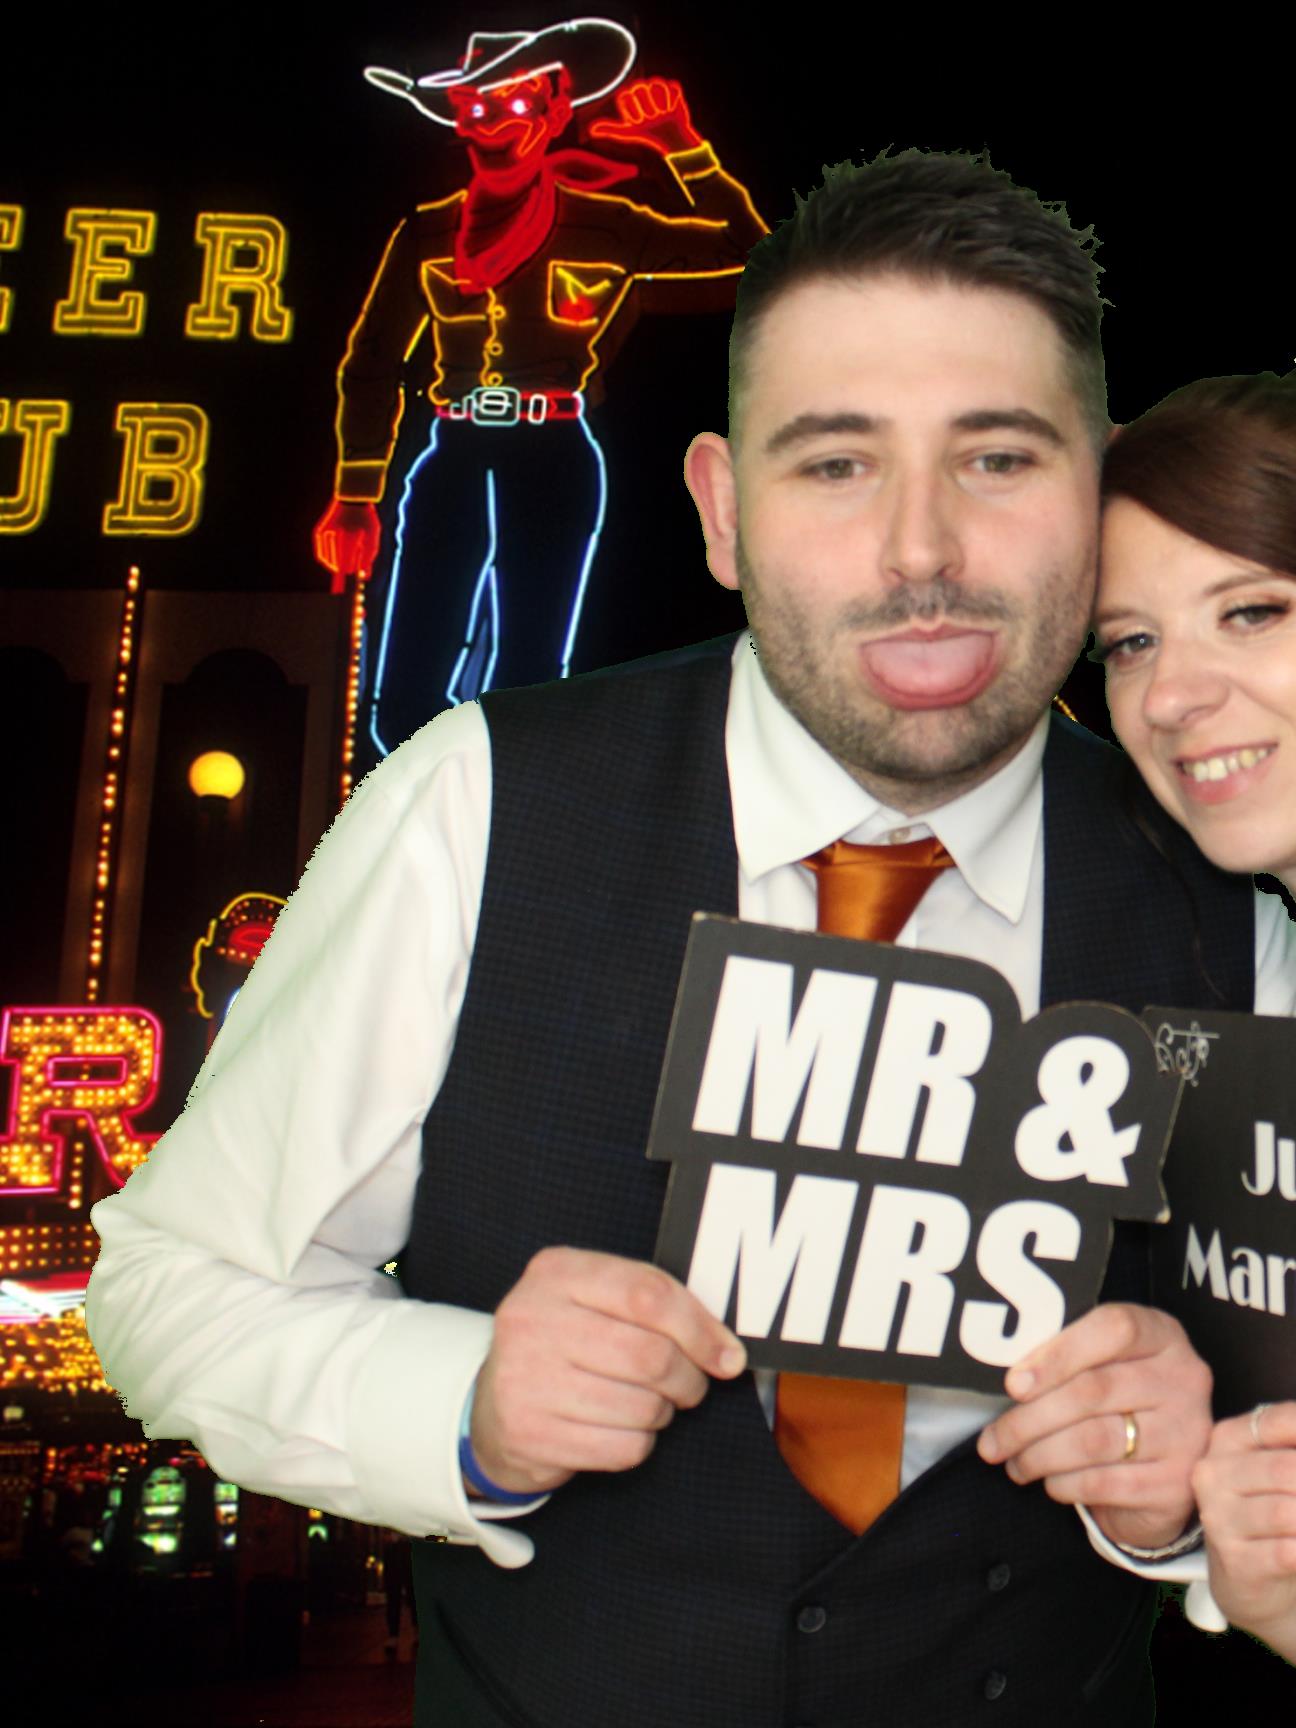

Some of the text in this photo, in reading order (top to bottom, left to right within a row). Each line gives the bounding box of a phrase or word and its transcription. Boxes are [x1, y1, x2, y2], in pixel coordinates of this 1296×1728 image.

[692, 955, 1142, 1188] MR &
[686, 1162, 1082, 1368] MRS
